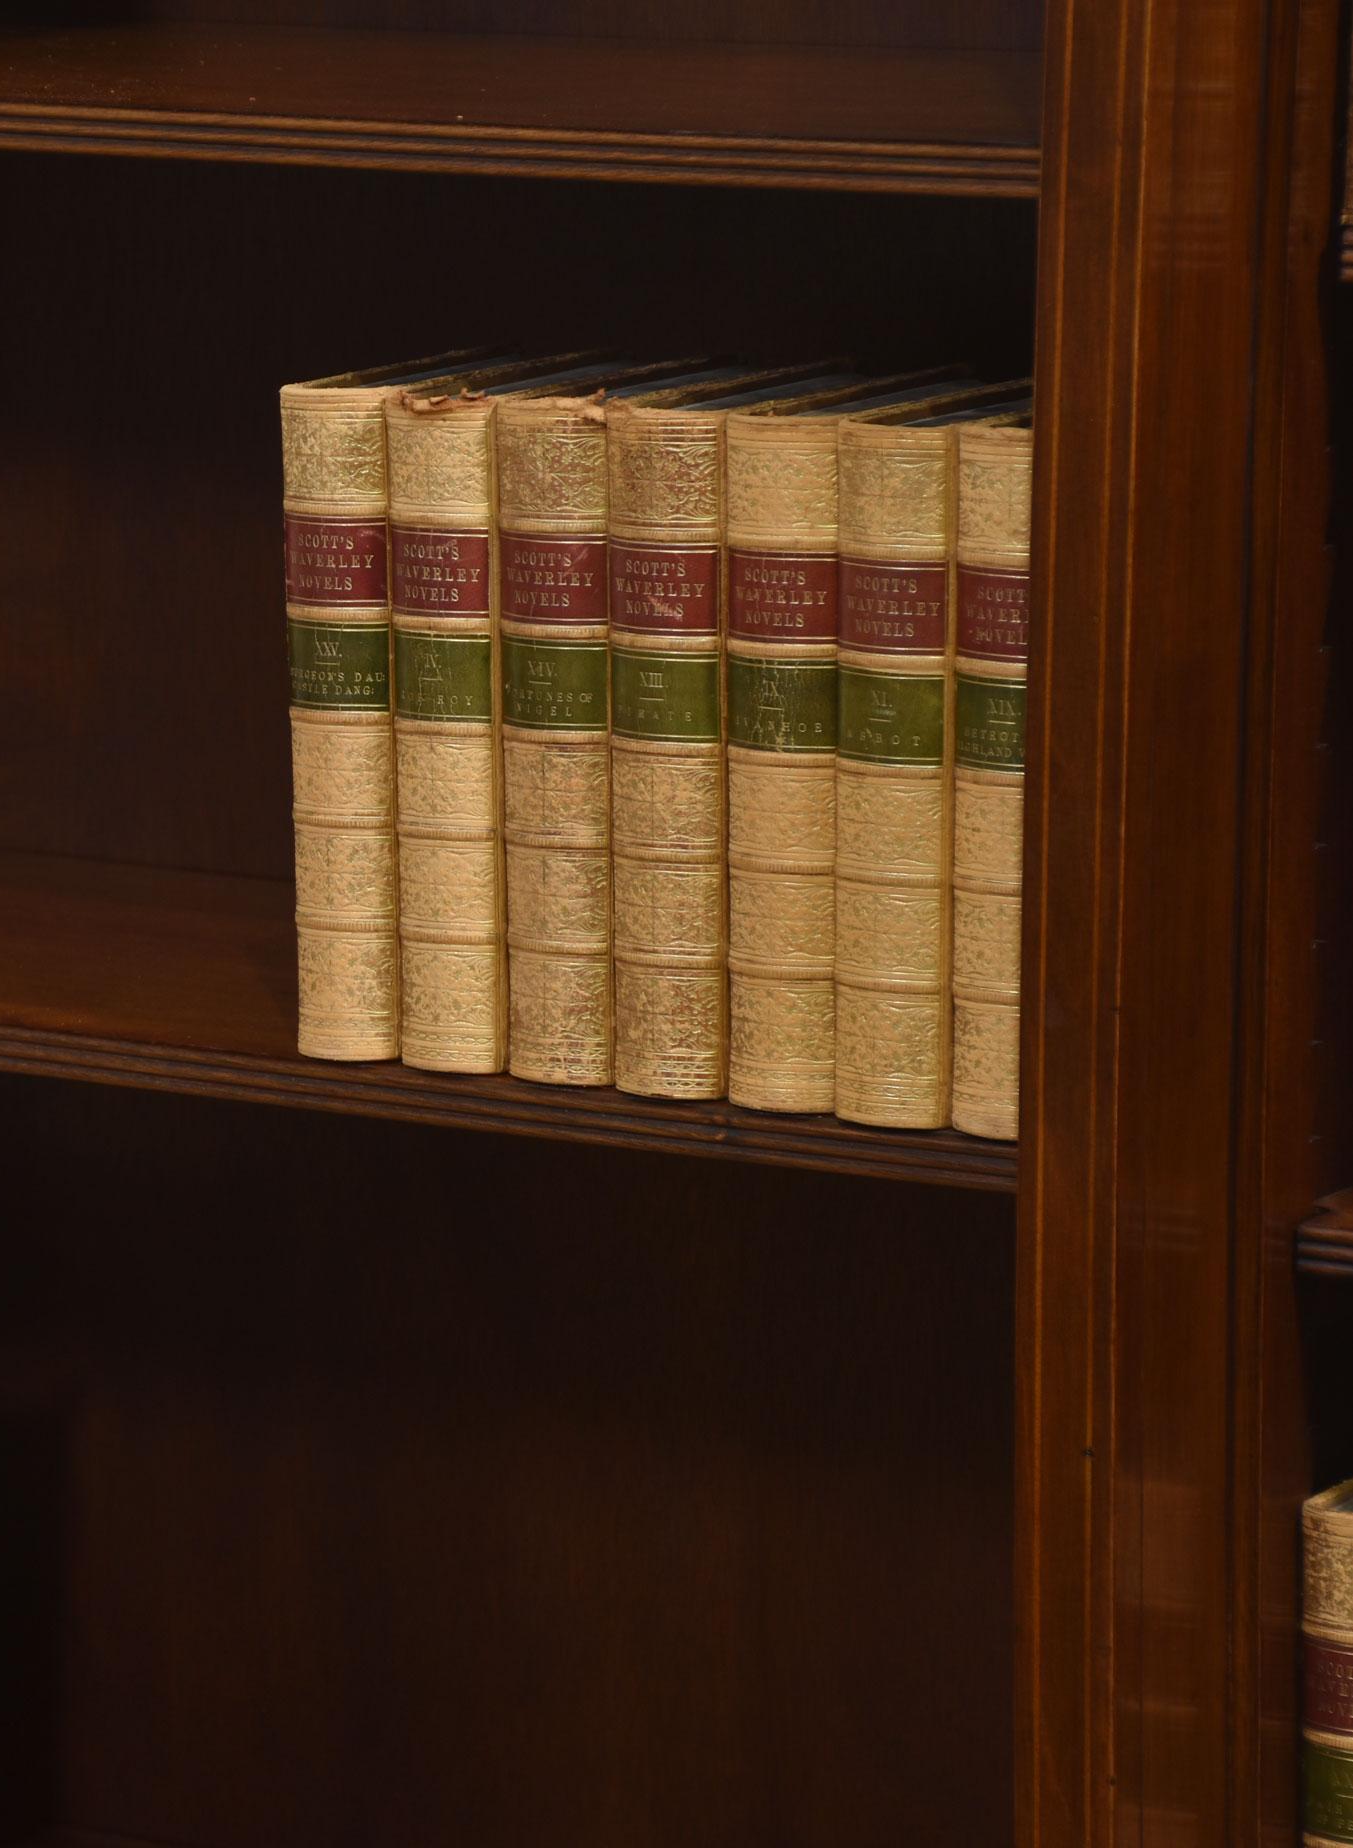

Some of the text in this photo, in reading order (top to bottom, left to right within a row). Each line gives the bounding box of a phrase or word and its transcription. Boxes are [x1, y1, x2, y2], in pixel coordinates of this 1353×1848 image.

[297, 534, 354, 550] SCOTT'S
[290, 552, 376, 569] WAVERLEY
[403, 543, 460, 561] SCOTT'S
[514, 551, 573, 568] SCOTT'S
[397, 563, 481, 583] WAVERLEY
[506, 567, 594, 587] WAVERLEY
[625, 559, 687, 577] SCOTT'S
[297, 574, 354, 592] NOVELS
[744, 569, 806, 586] SCOTT'S
[855, 577, 918, 594] SCOTT'S
[404, 584, 460, 603] NOVELS
[615, 575, 705, 599] WAVERLEY
[977, 585, 1027, 603] SCOTT
[514, 590, 571, 608] NOVELS
[736, 587, 828, 606] WAVERLEY
[848, 595, 941, 617] WAVERLEY
[745, 610, 805, 628] NOVELS
[855, 619, 915, 638] NOVELS
[976, 626, 1028, 646] NOVEL
[291, 681, 329, 696] STLE
[437, 694, 473, 707] ROY
[514, 702, 573, 718] NIGEL
